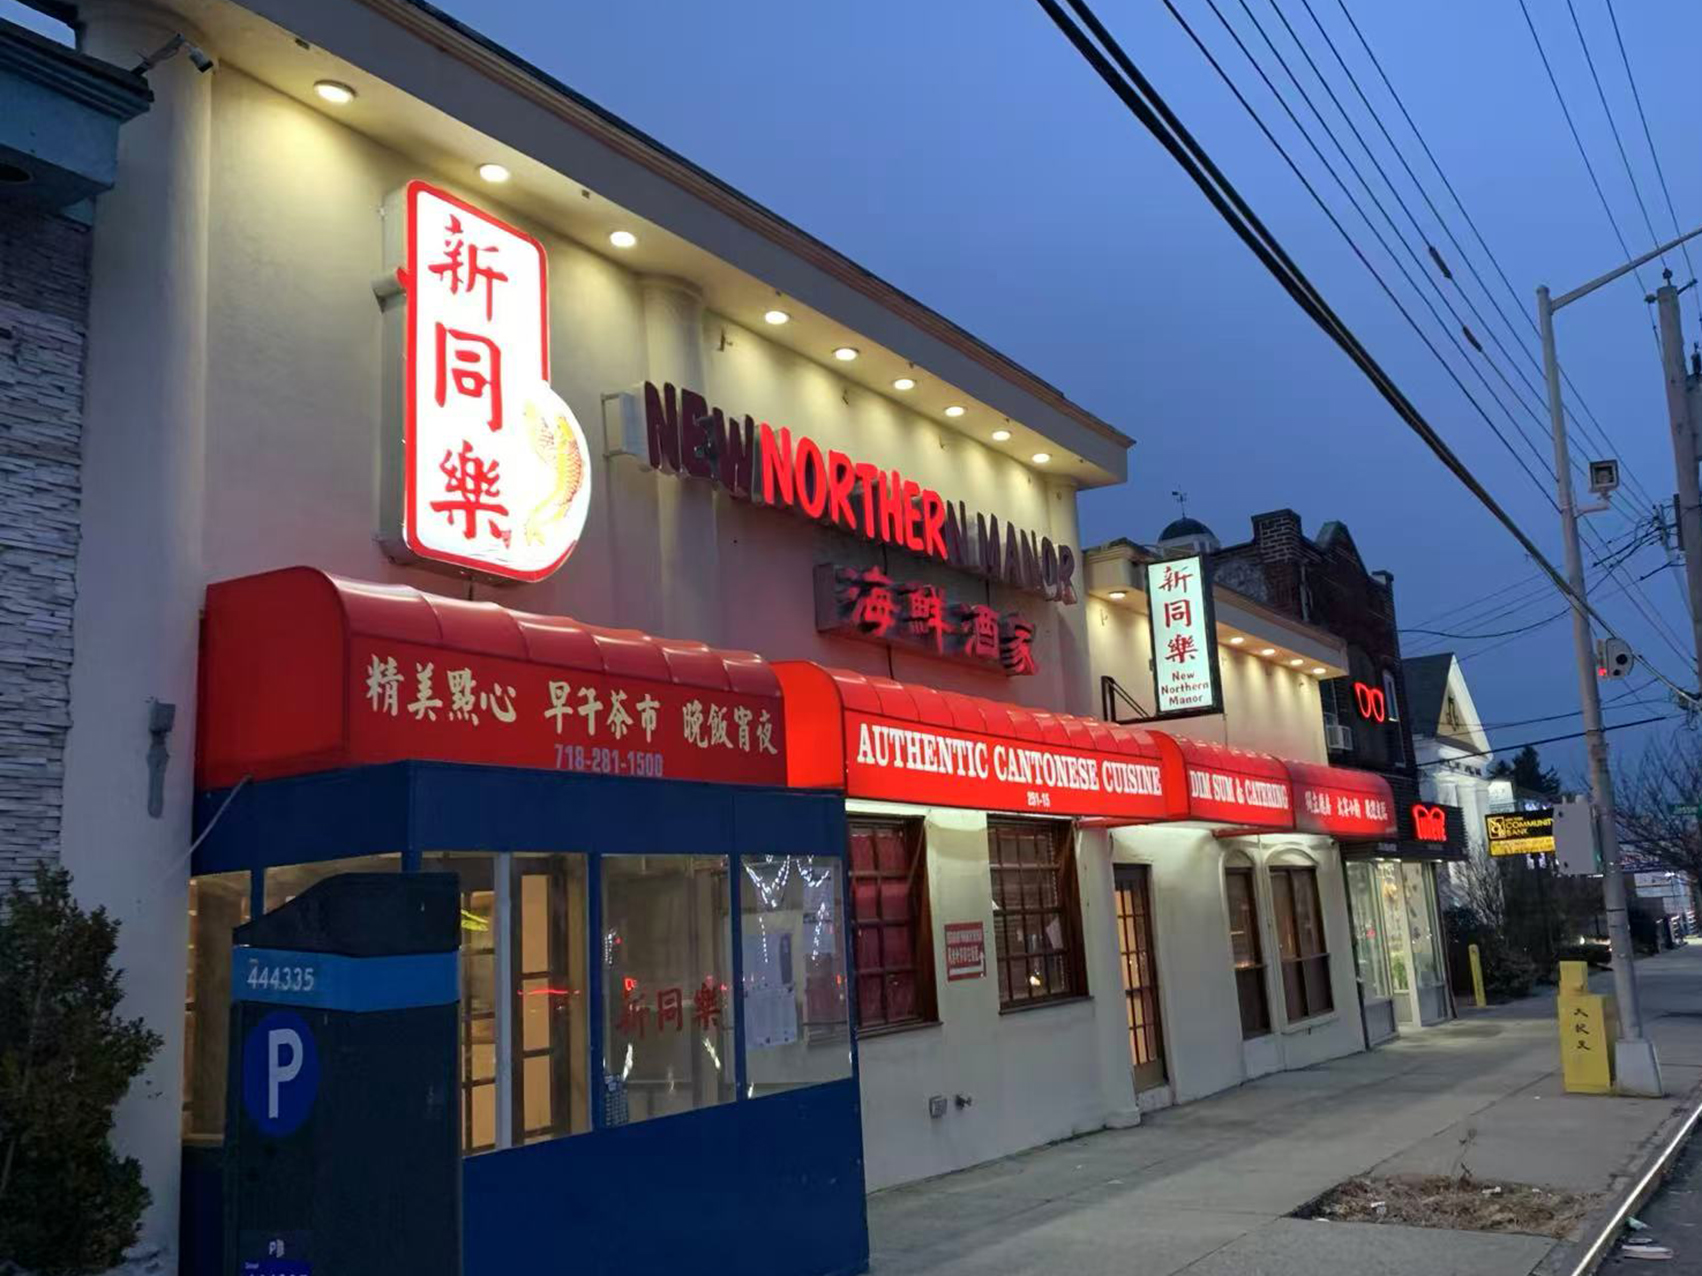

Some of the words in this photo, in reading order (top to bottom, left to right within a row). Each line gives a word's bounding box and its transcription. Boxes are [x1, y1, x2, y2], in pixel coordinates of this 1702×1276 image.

[428, 213, 511, 543] 新同樂
[644, 380, 755, 499] NEW
[760, 421, 970, 568] NORTHERN
[976, 511, 1077, 604] MANOR
[844, 566, 1038, 676] 海鮮酒家
[1158, 566, 1198, 664] 新同樂
[365, 654, 517, 726] 精美點心
[544, 681, 661, 742] 早午茶市
[682, 699, 779, 755] 晚飯宵夜
[1161, 681, 1209, 696] Northern
[1169, 694, 1203, 706] Manor
[1172, 670, 1195, 682] New
[554, 743, 663, 777] 718-281-1500
[857, 723, 988, 780] AUTHENTIC
[993, 745, 1099, 791] CANTONESE
[1101, 760, 1163, 796] CUISINE
[1189, 770, 1213, 800] DIM
[1212, 774, 1236, 803] SUM
[1235, 778, 1245, 804] &
[1244, 779, 1289, 809] CATERING
[247, 967, 315, 992] 444335
[268, 1028, 304, 1119] P
